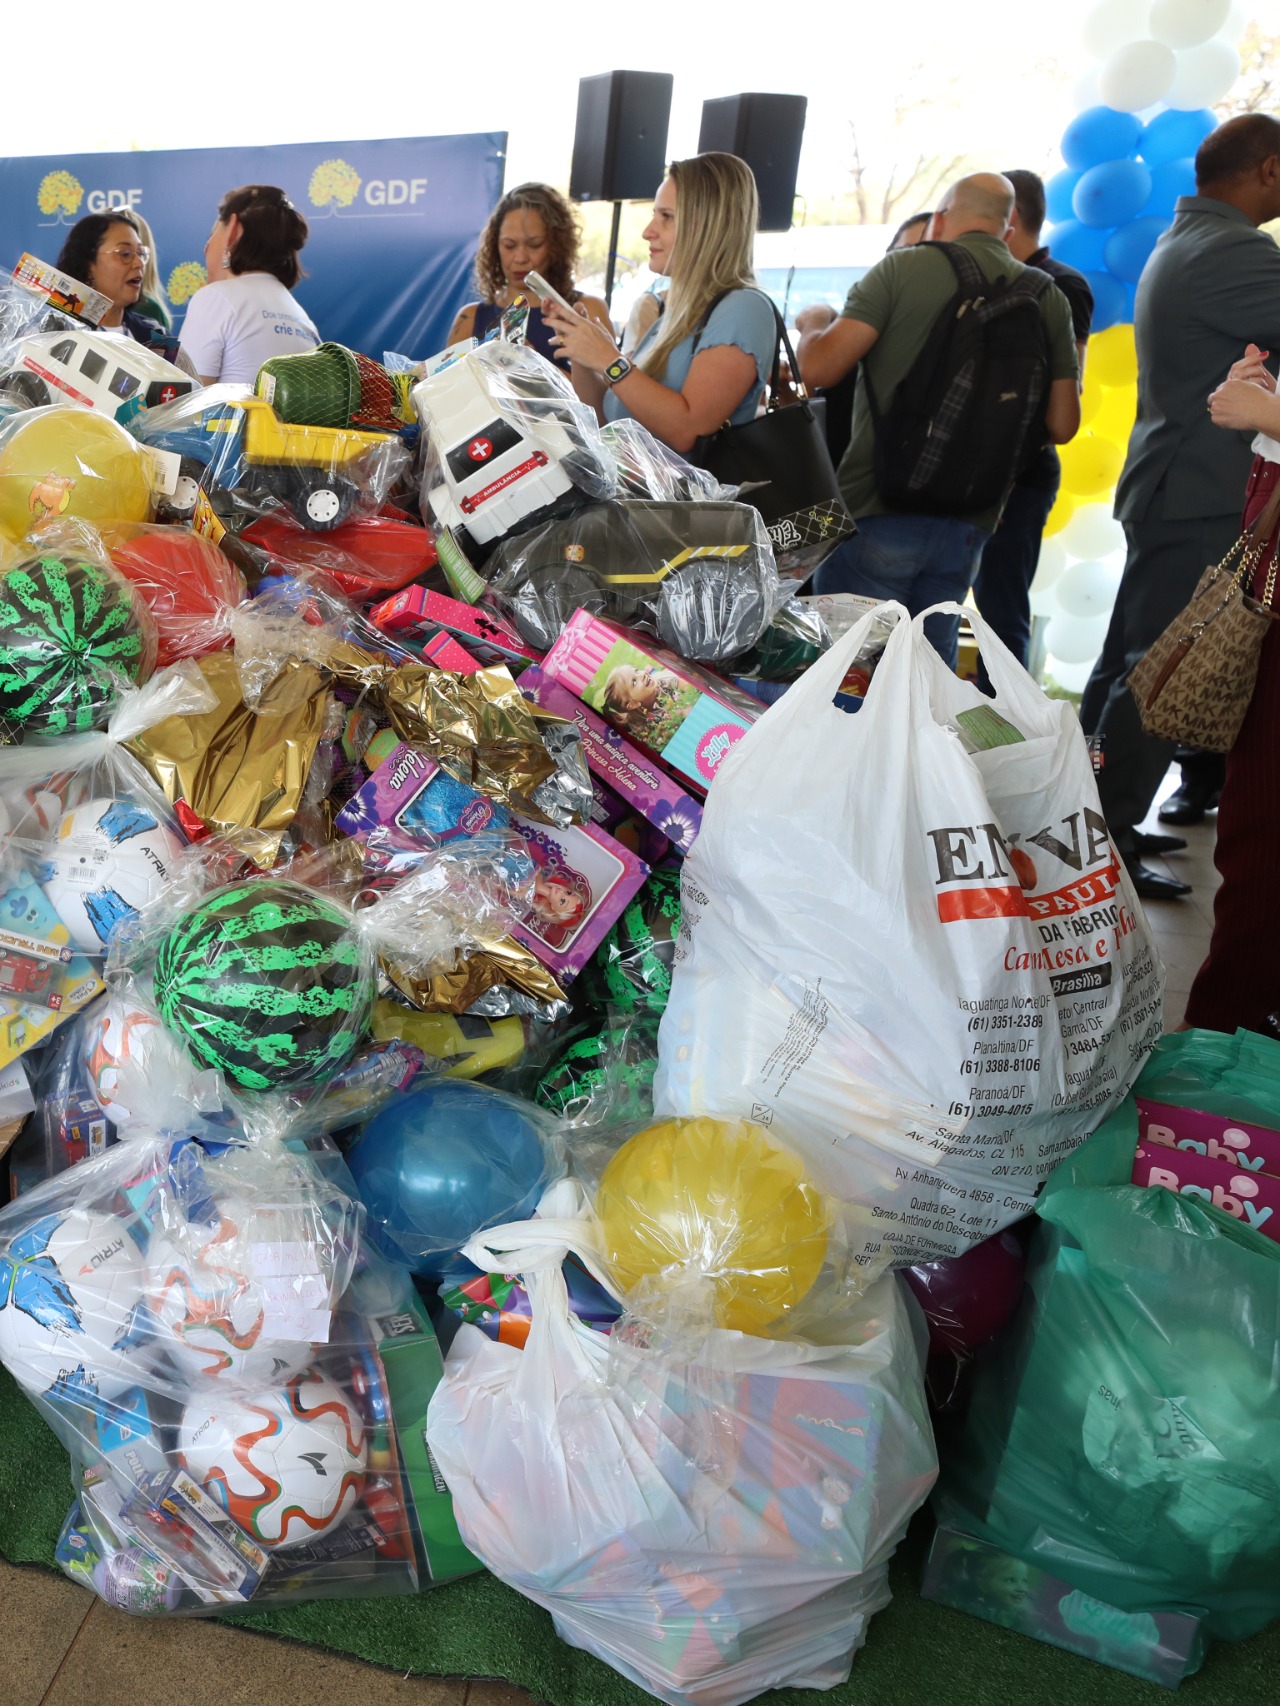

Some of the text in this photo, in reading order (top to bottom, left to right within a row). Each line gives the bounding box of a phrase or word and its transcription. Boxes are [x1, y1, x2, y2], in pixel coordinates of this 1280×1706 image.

[87, 189, 142, 213] GDF
[364, 179, 428, 206] GDF
[274, 323, 293, 337] crie
[482, 468, 523, 497] AMBULÂNCIA
[575, 709, 660, 791] Viva uma mágica aventura
[701, 731, 731, 767] Lilly
[581, 738, 638, 792] Princesa Helena
[1039, 925, 1064, 944] DA
[1052, 973, 1102, 993] Brasília
[958, 996, 1008, 1014] Taguatinga
[1073, 997, 1108, 1017] Central
[967, 1014, 1043, 1033] (61) 3351-2389
[1061, 1015, 1105, 1039] Gama/DF
[973, 1038, 1035, 1055] Planaltina/DF
[960, 1058, 1041, 1076] (61) 3388-8106
[969, 1084, 1026, 1100] Paranoá/DF
[948, 1100, 1034, 1121] (61) 3049-4015
[905, 1130, 1025, 1160] Av. Alagados, CL 115
[934, 1127, 1015, 1147] Santa Maria/DF
[992, 1165, 1009, 1176] QN
[896, 1166, 910, 1181] Av.
[912, 1171, 967, 1199] Anhanguera
[969, 1189, 994, 1204] 4858
[1003, 1195, 1034, 1213] Centr
[871, 1206, 944, 1231] Santo Antônio do
[910, 1197, 999, 1229] Quadra 62, Lote 11
[864, 1242, 881, 1254] RUA
[906, 1234, 916, 1245] DE
[90, 1238, 126, 1269] ATRIO
[191, 1420, 211, 1445] ATRIO
